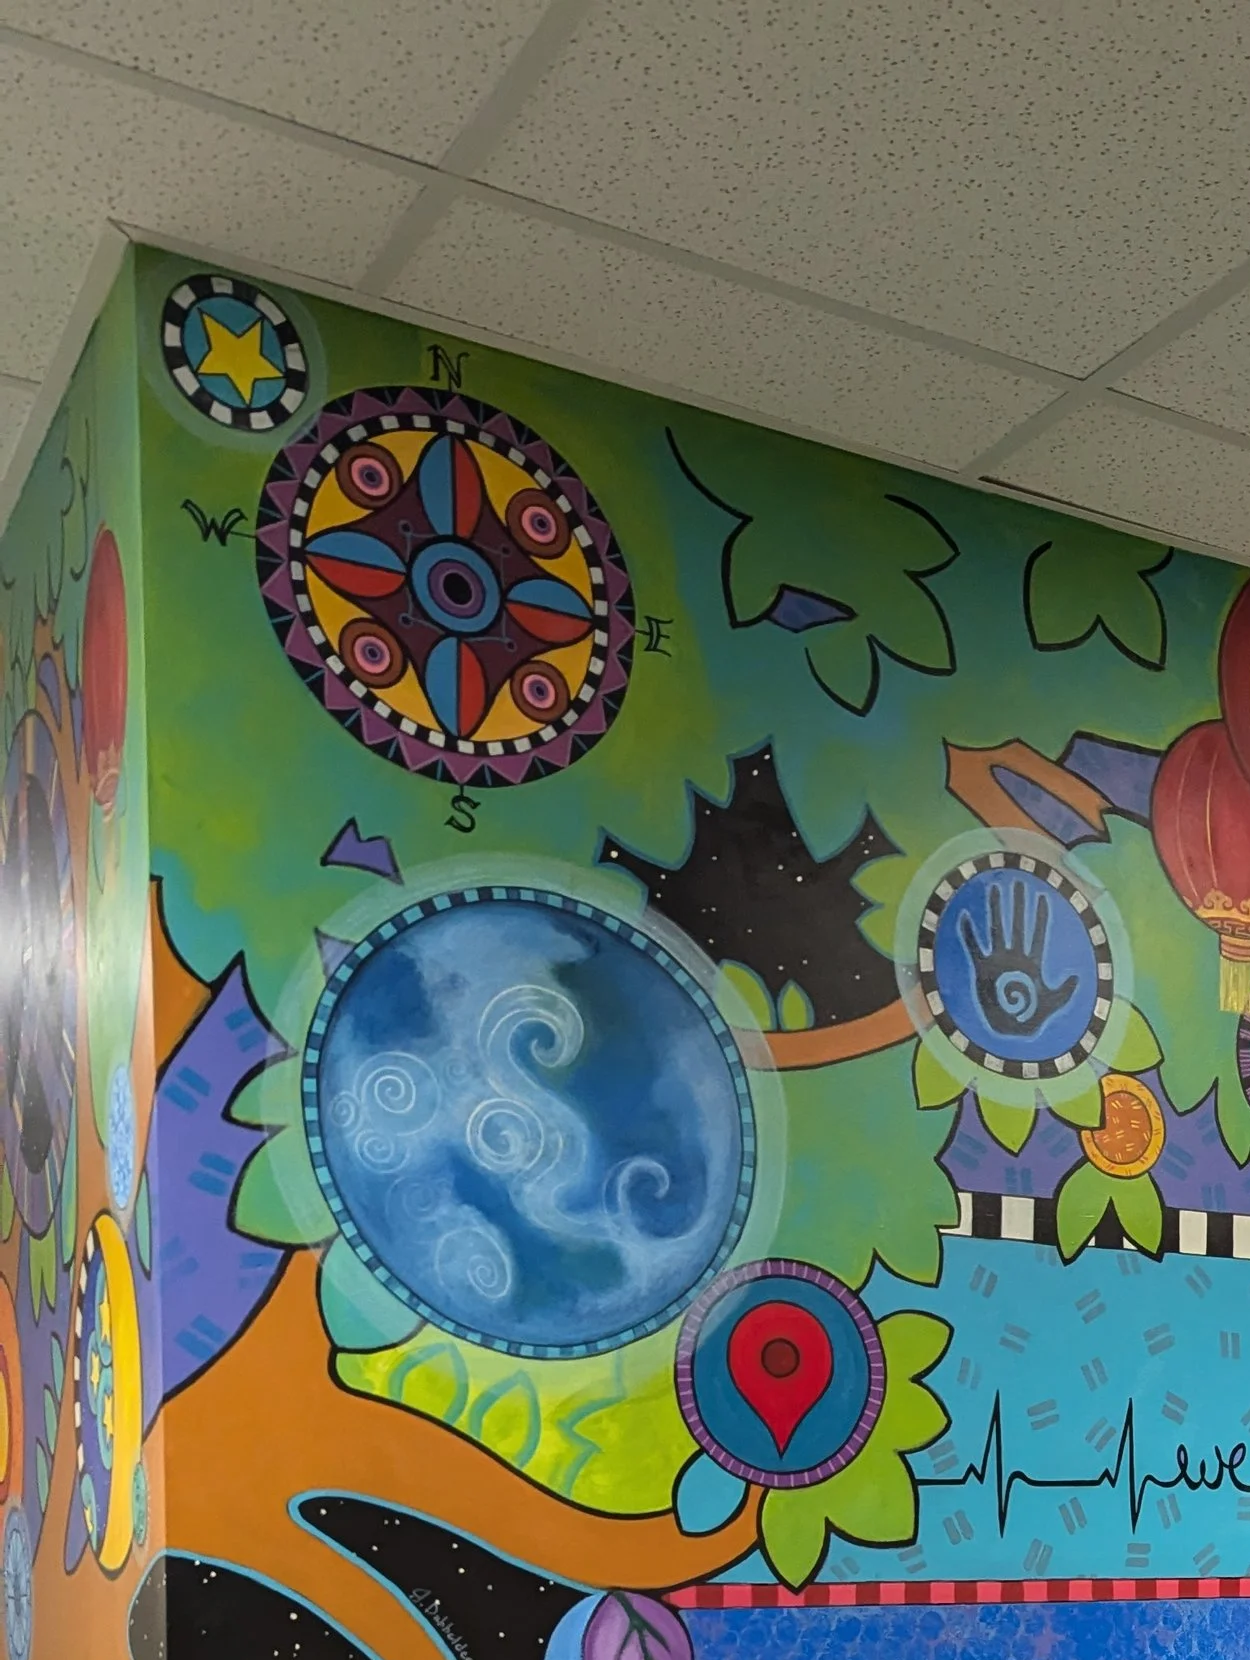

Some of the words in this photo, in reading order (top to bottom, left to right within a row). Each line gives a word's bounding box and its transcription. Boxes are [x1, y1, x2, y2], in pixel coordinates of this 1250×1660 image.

[427, 344, 469, 390] N
[181, 498, 248, 546] W
[642, 615, 673, 657] E
[444, 794, 482, 833] S
